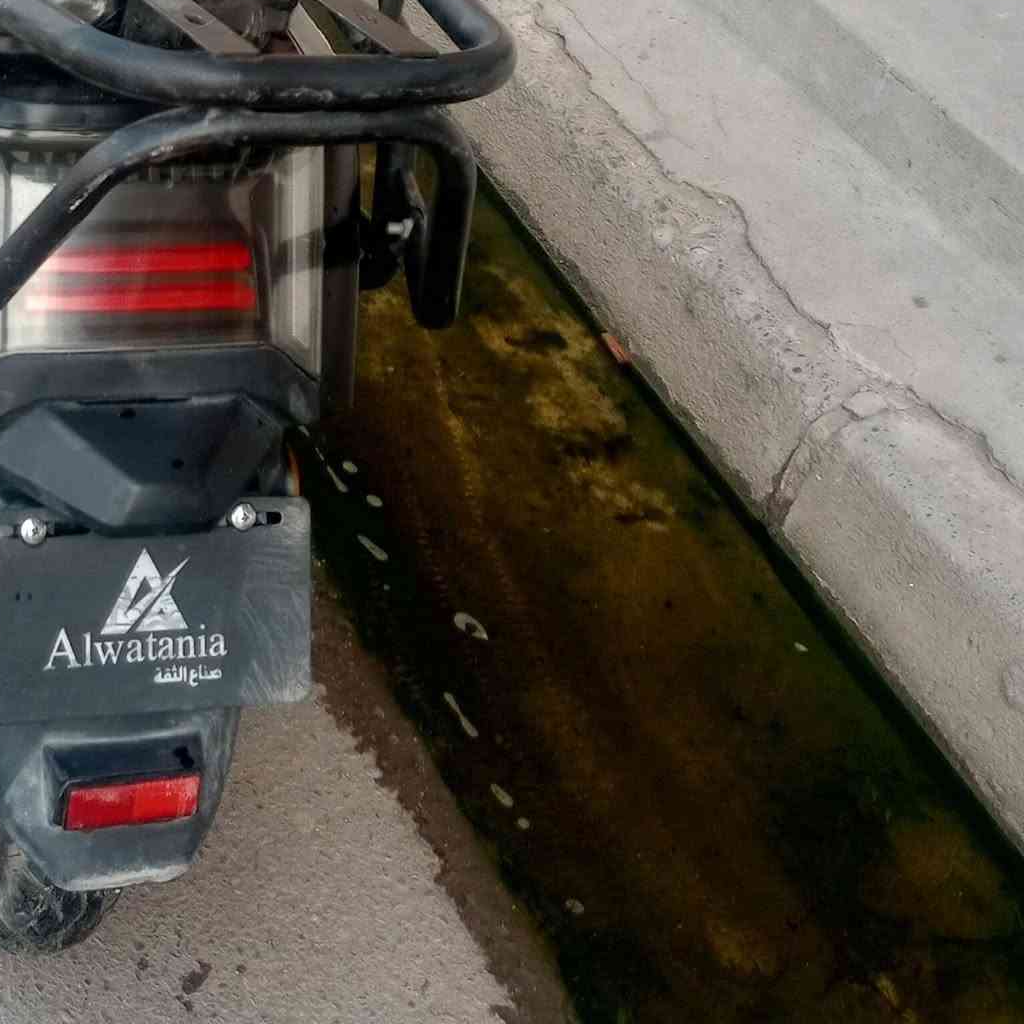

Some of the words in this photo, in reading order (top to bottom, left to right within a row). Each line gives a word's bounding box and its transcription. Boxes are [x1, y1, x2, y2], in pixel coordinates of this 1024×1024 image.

[43, 624, 227, 670] Alwatania
[153, 665, 187, 684] الثقة
[187, 663, 223, 688] صناع
